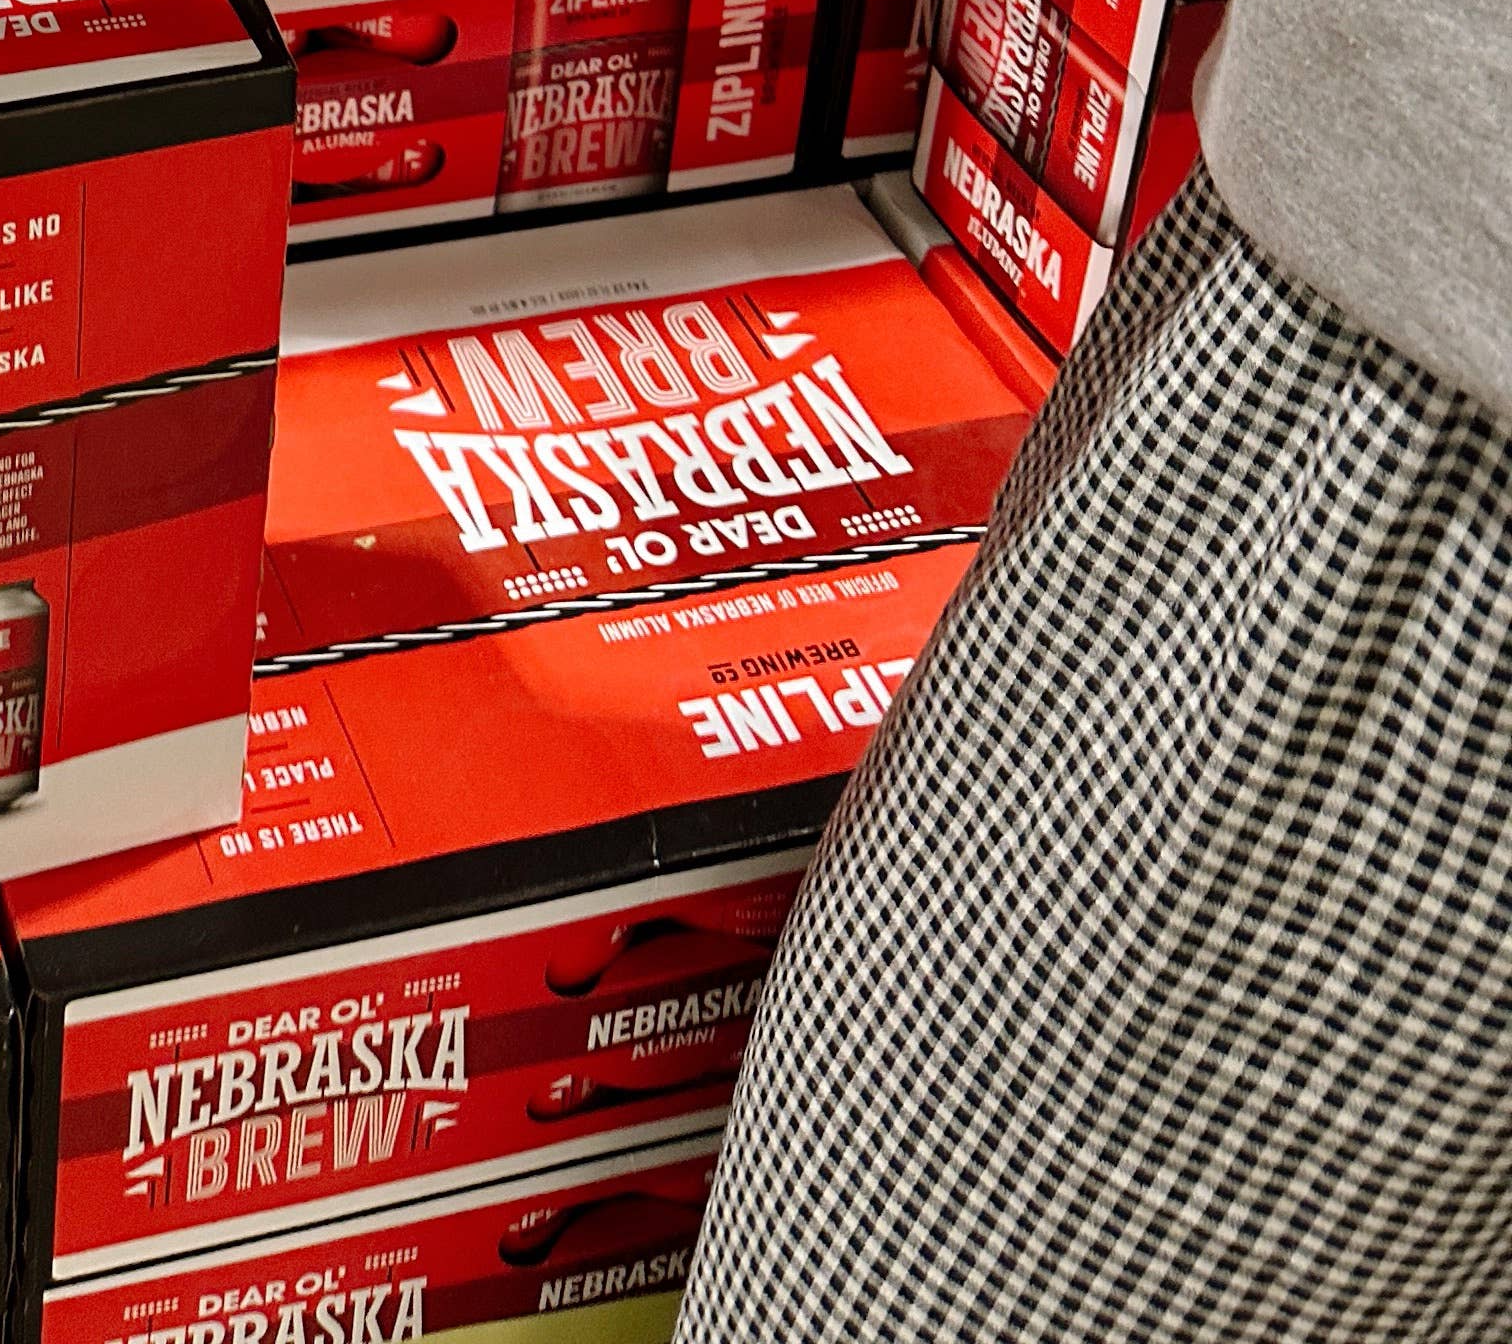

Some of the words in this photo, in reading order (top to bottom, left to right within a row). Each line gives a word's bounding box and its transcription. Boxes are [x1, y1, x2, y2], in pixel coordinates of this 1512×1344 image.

[296, 89, 414, 135] EBRASKA
[522, 119, 646, 180] BREW
[29, 213, 62, 241] NO
[942, 136, 1062, 303] NEBRASKA
[0, 279, 55, 311] LIKE
[447, 300, 759, 432] BREW
[394, 354, 915, 554] NEBRASKA
[687, 504, 818, 558] DEAR
[597, 615, 672, 644] ALUMNI
[672, 593, 775, 631] NEBRASKA
[741, 638, 862, 679] BREWING
[262, 757, 335, 789] PLACE
[289, 811, 364, 845] THERE
[228, 1009, 321, 1047] DEAR
[124, 1004, 470, 1162] NEBRASKA
[187, 1092, 406, 1201] BREW
[198, 1284, 284, 1318] DEAR
[539, 1250, 689, 1312] NEBRASK
